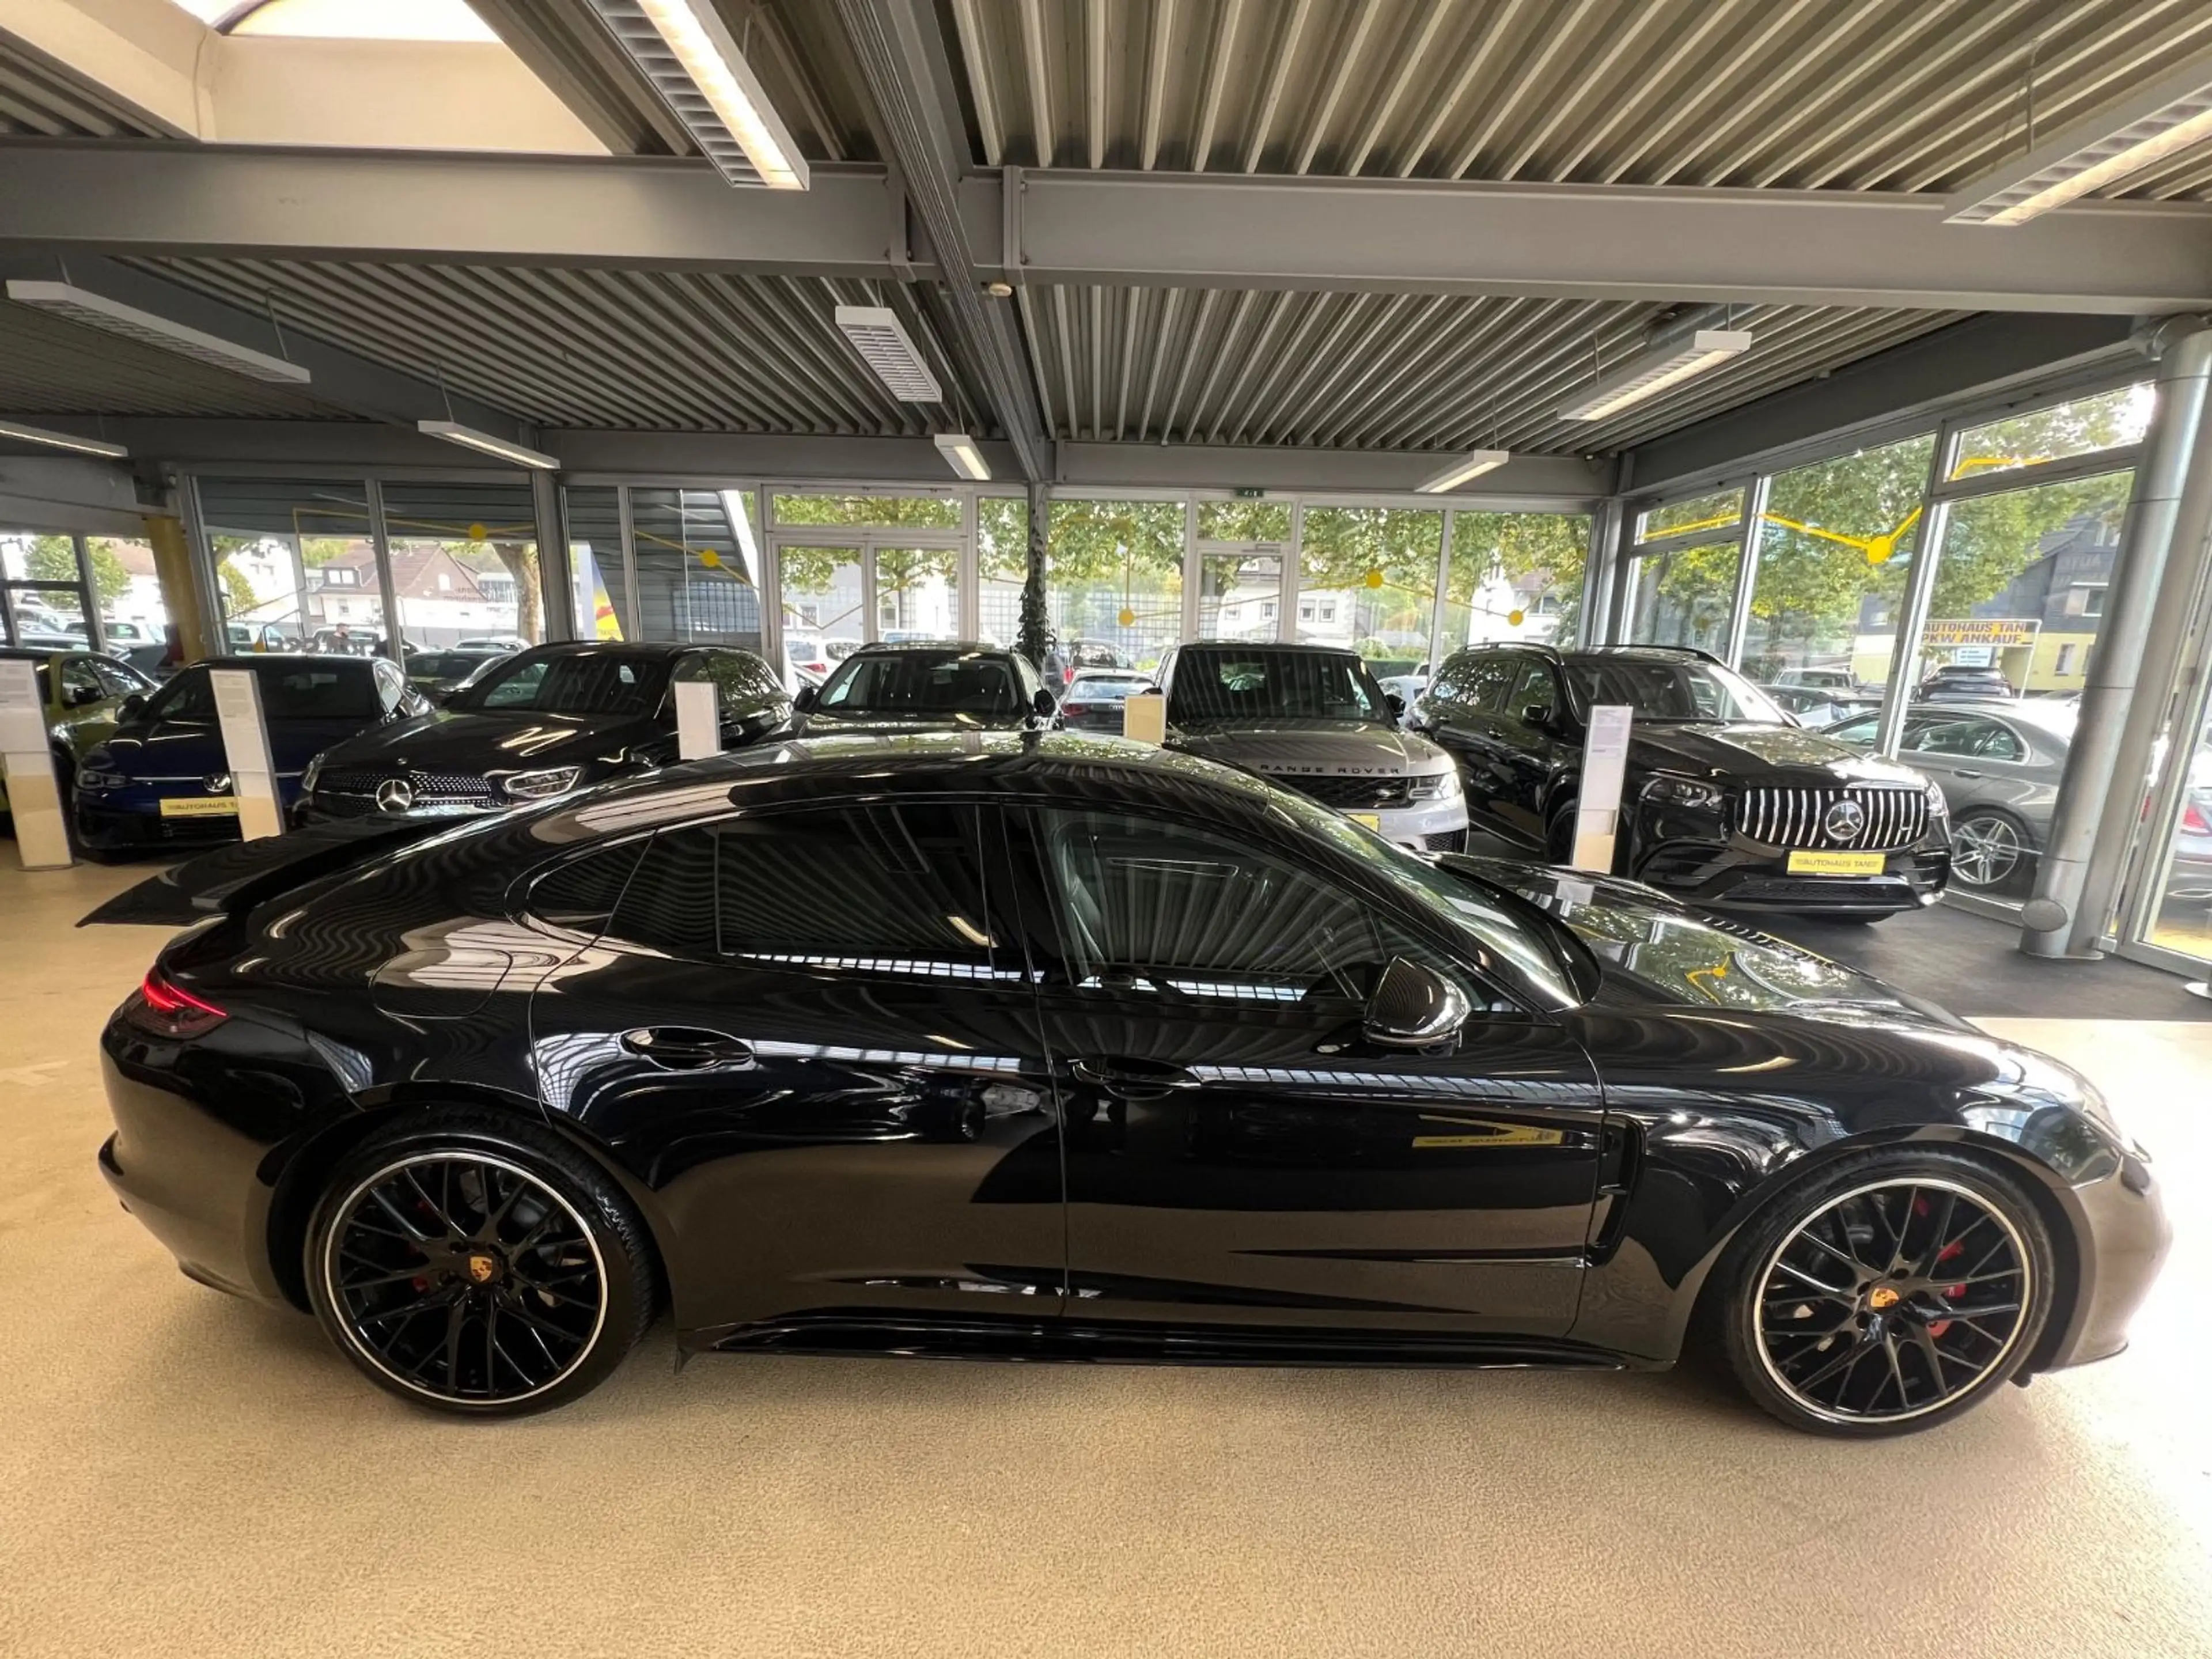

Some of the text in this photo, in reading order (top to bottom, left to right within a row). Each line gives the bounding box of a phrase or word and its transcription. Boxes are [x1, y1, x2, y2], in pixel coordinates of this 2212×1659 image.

[1923, 622, 1993, 632] AUTOHAUS
[1922, 634, 2022, 643] PKW ANKAUF
[1260, 764, 1324, 773] RANGE
